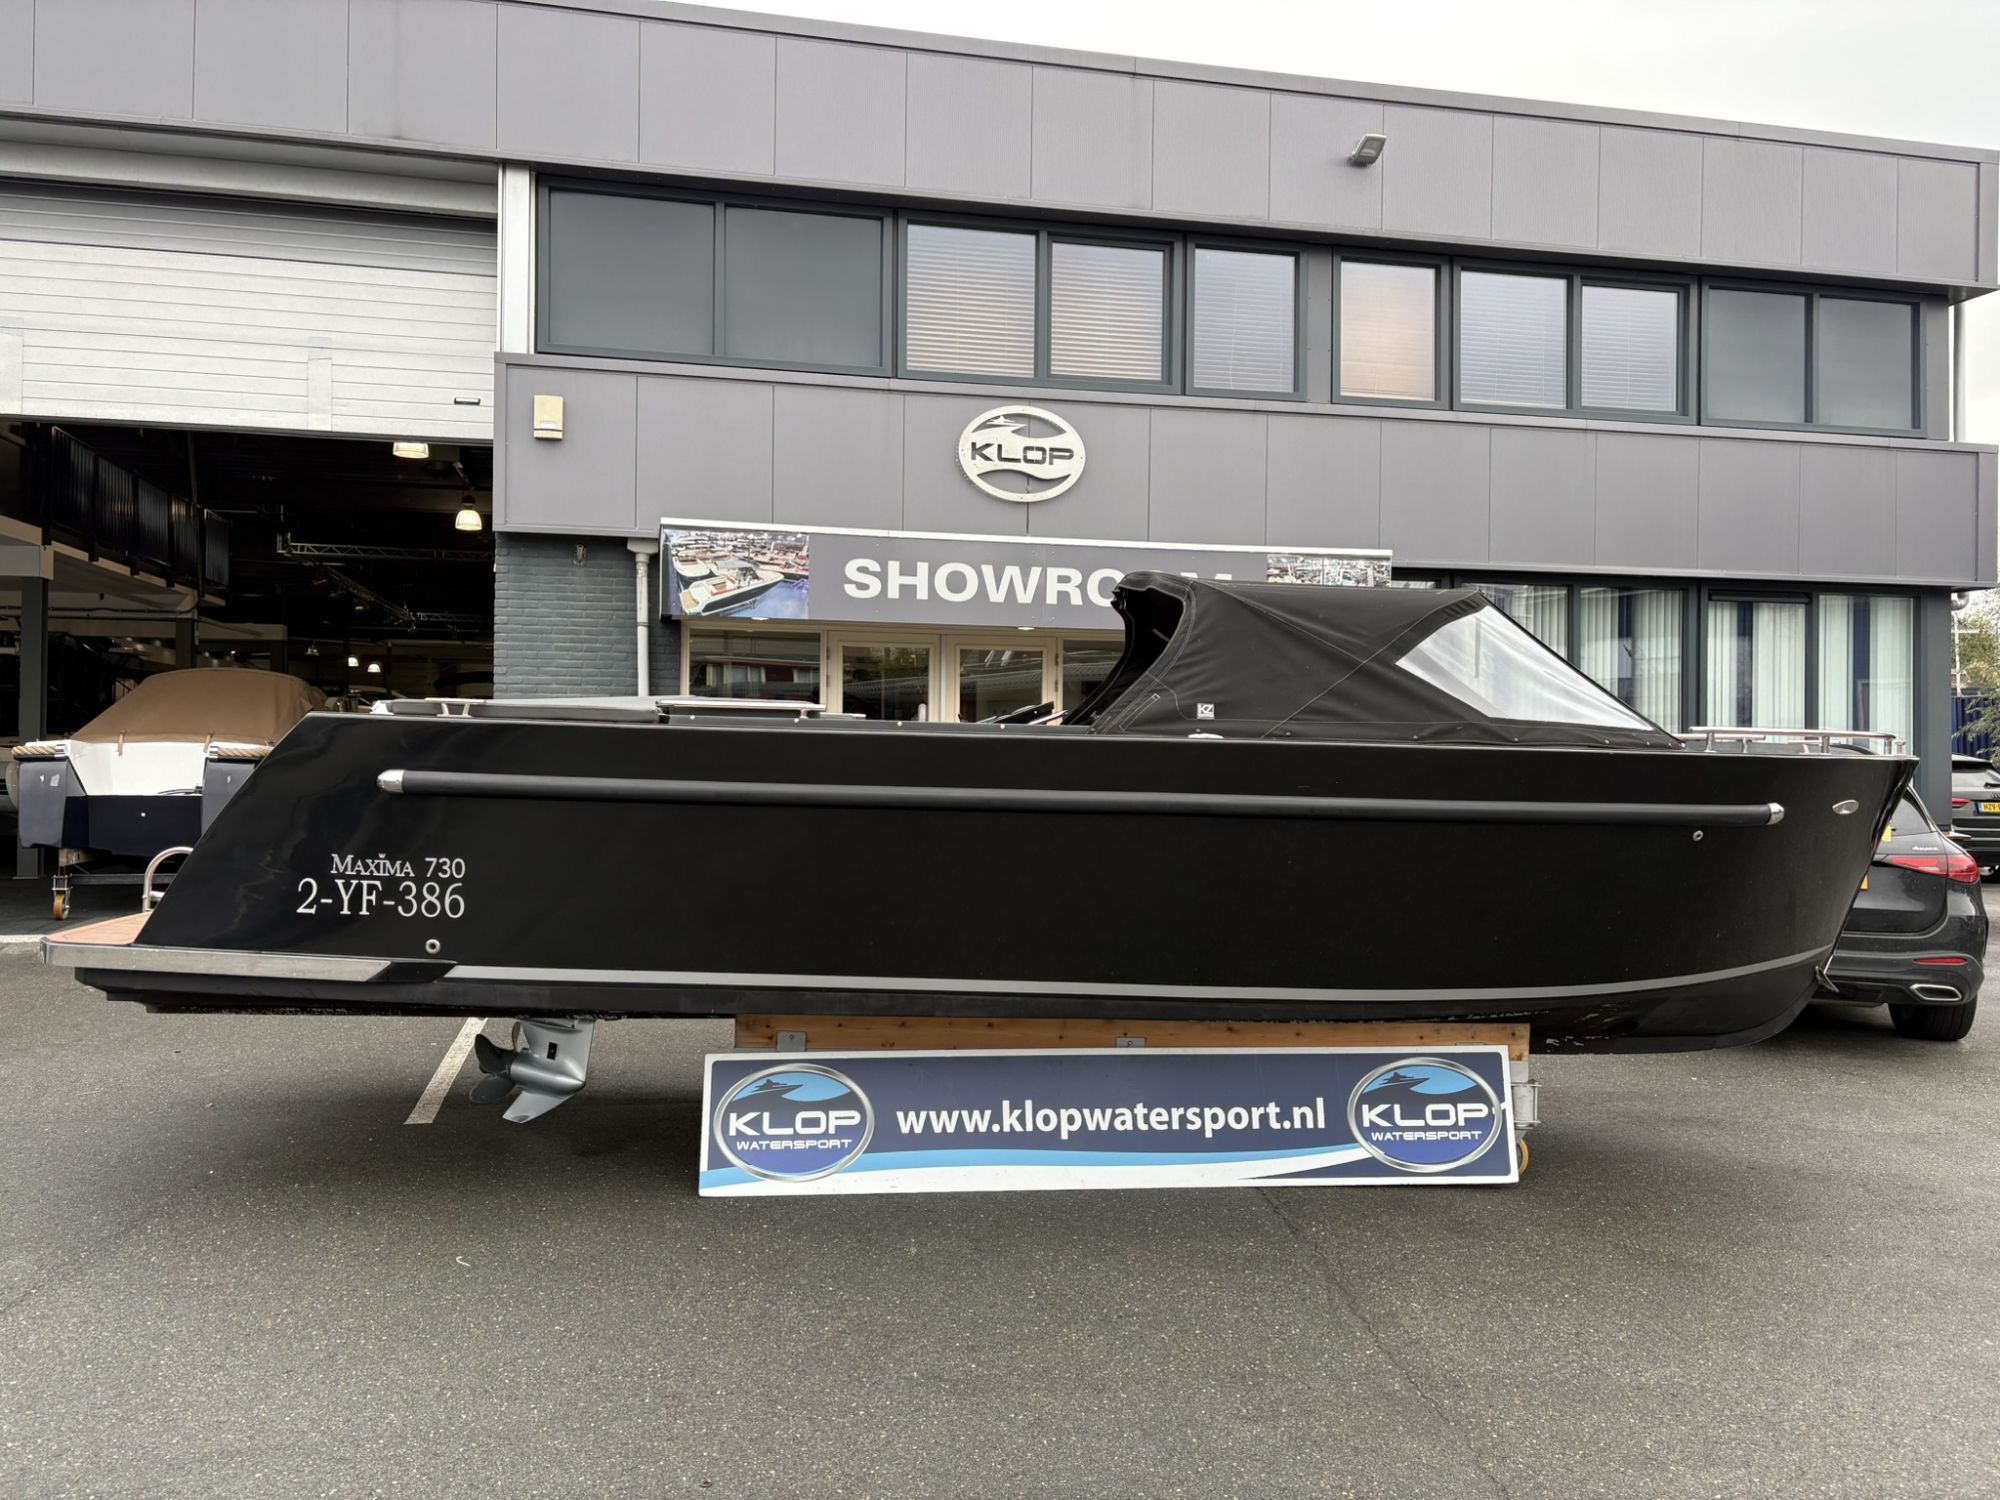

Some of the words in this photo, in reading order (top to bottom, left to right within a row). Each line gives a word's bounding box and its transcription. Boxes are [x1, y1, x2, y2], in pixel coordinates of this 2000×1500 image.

[970, 441, 1075, 466] KLOP
[844, 557, 1233, 608] SHOWRO
[425, 857, 466, 878] 730
[296, 877, 465, 918] 2-YF-386
[728, 1110, 861, 1136] KLOP
[896, 1097, 1326, 1140] www.klopwatersport.nl
[1361, 1103, 1489, 1128] KLOP
[736, 1139, 852, 1150] WATERSPORT
[1371, 1130, 1483, 1141] WATERSPORT
